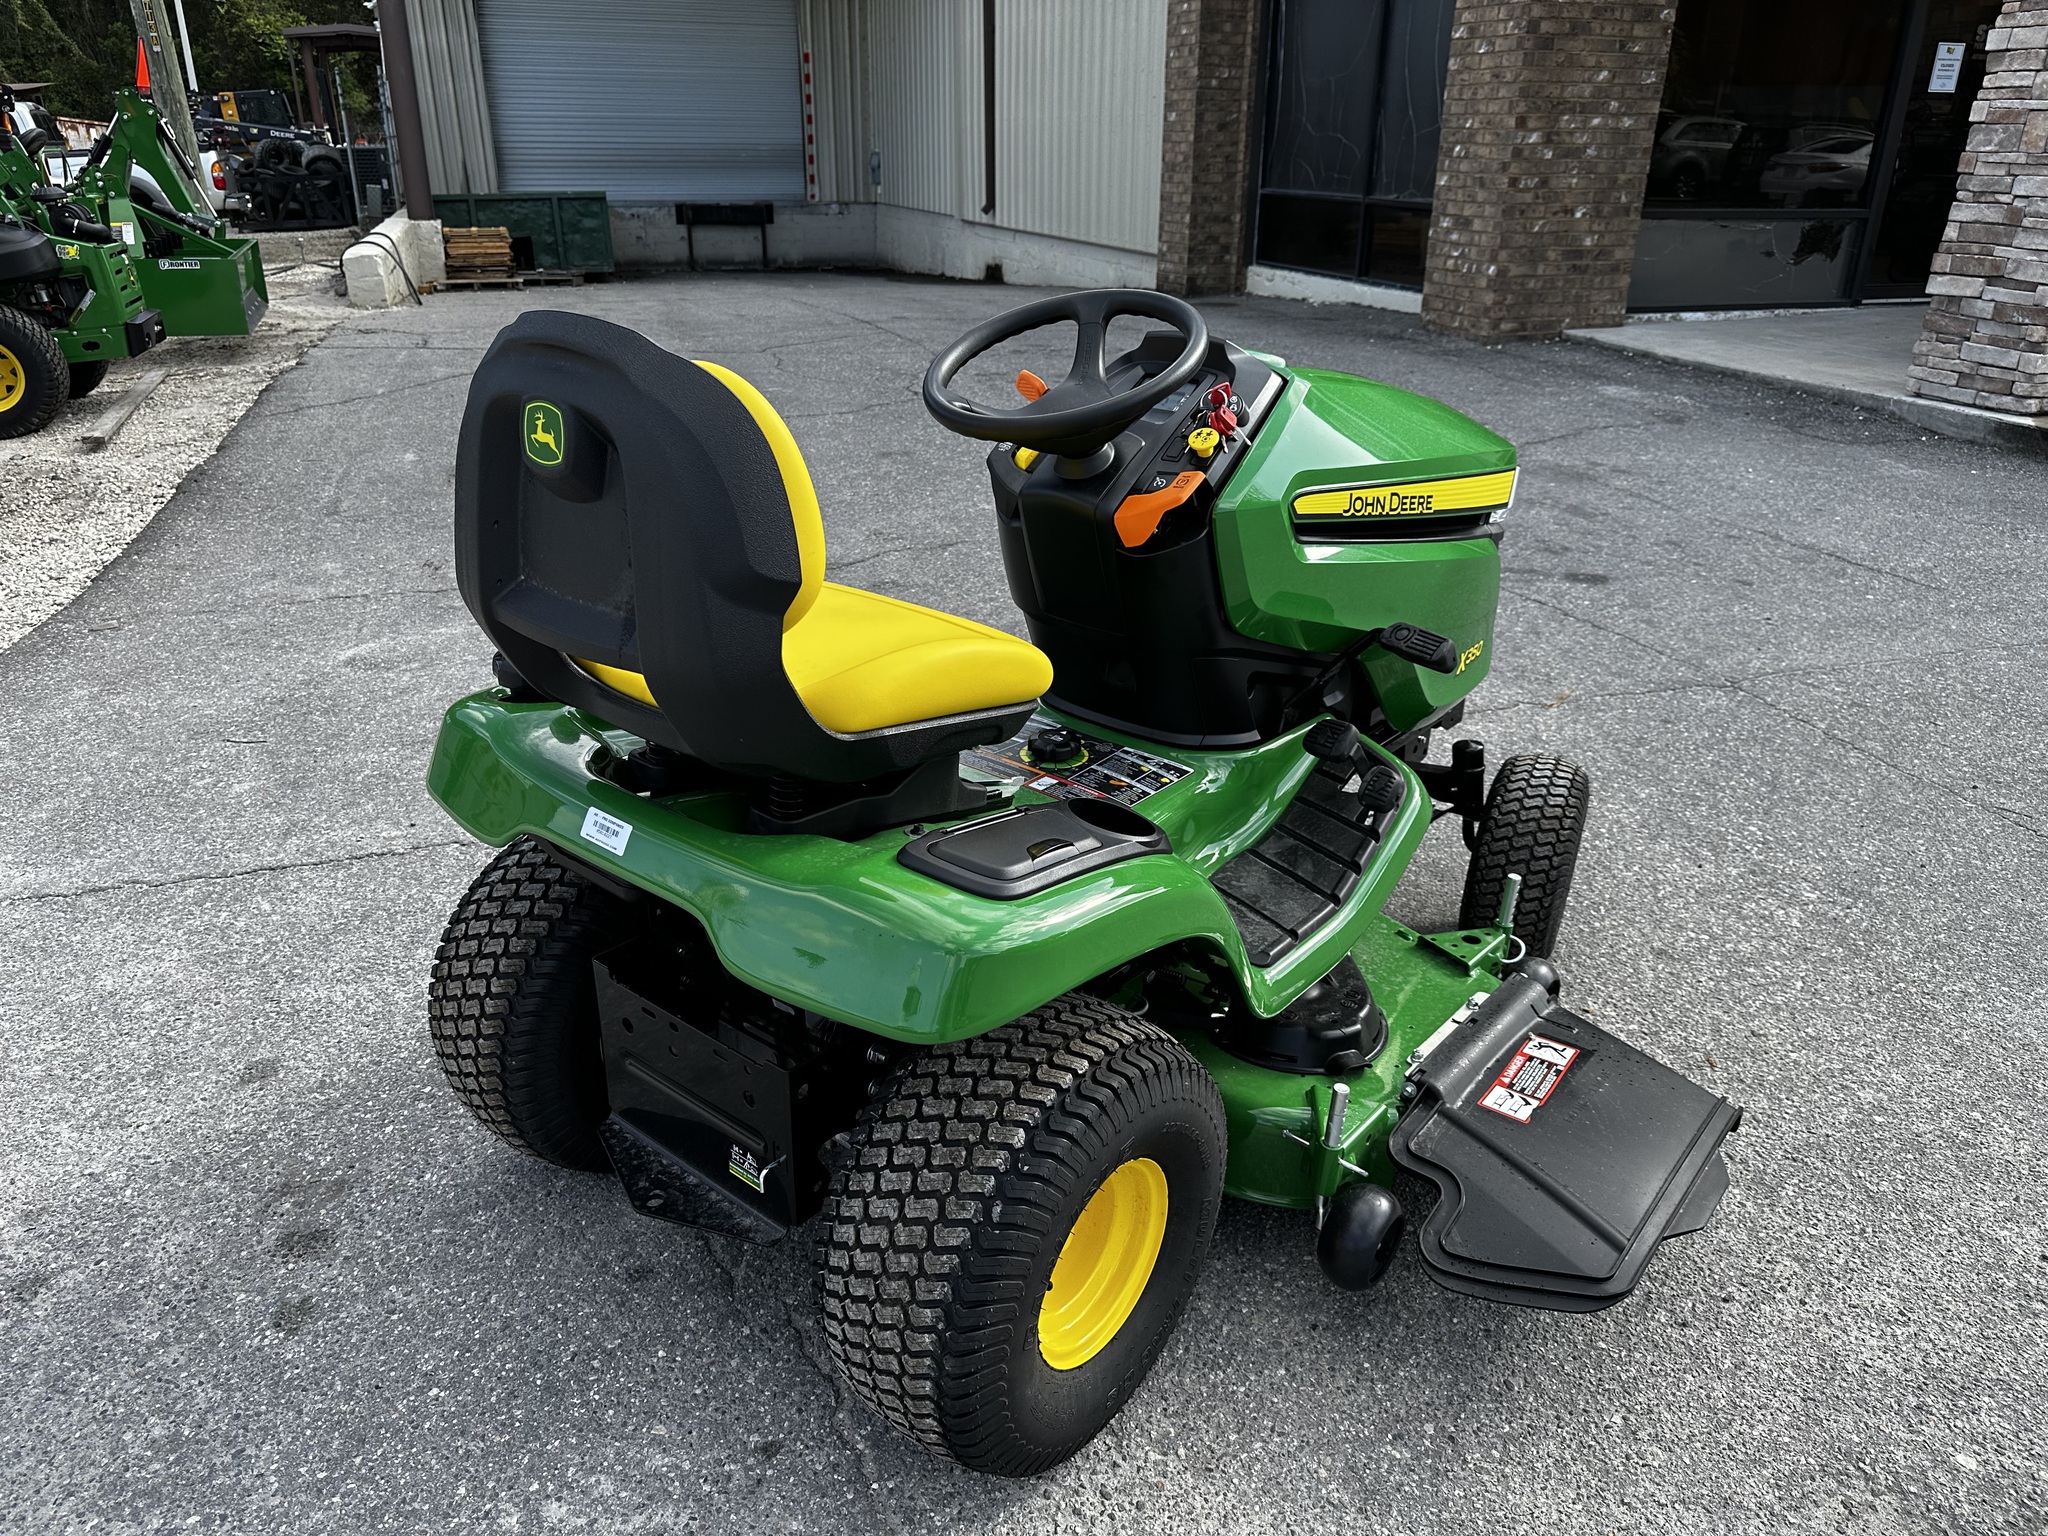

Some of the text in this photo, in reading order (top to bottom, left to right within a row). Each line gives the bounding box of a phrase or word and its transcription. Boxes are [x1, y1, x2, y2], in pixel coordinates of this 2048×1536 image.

[270, 130, 295, 139] DEERE
[160, 260, 199, 269] FRONTIER
[1343, 492, 1433, 514] JOHN DEERE
[1456, 640, 1484, 675] X350
[1504, 1055, 1526, 1078] DANGER
